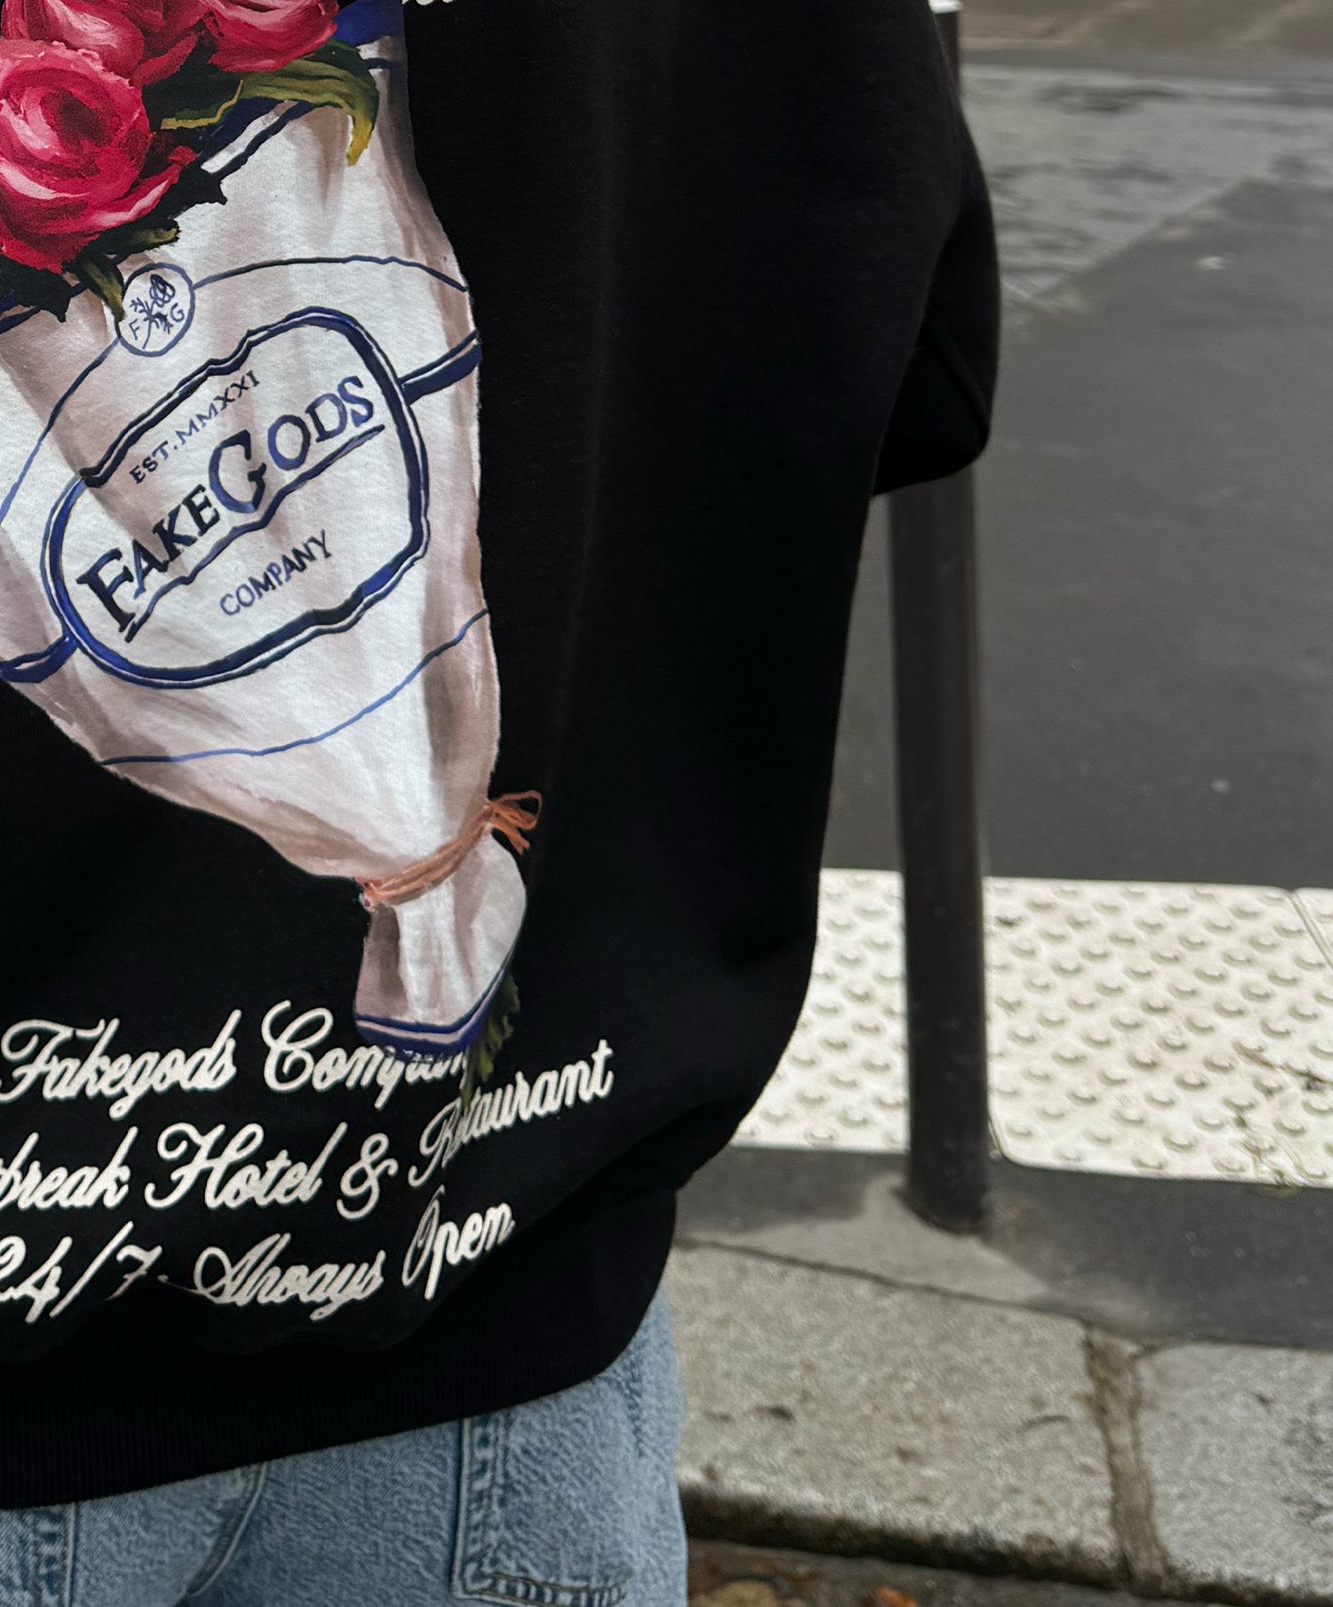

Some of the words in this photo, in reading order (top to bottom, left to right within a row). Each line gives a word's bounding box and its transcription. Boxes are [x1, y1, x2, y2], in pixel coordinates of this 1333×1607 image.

[220, 529, 332, 617] COMPANY
[145, 1121, 348, 1211] Hotel
[337, 1133, 399, 1220] &
[157, 1232, 387, 1321] Always
[402, 1184, 516, 1300] Open
